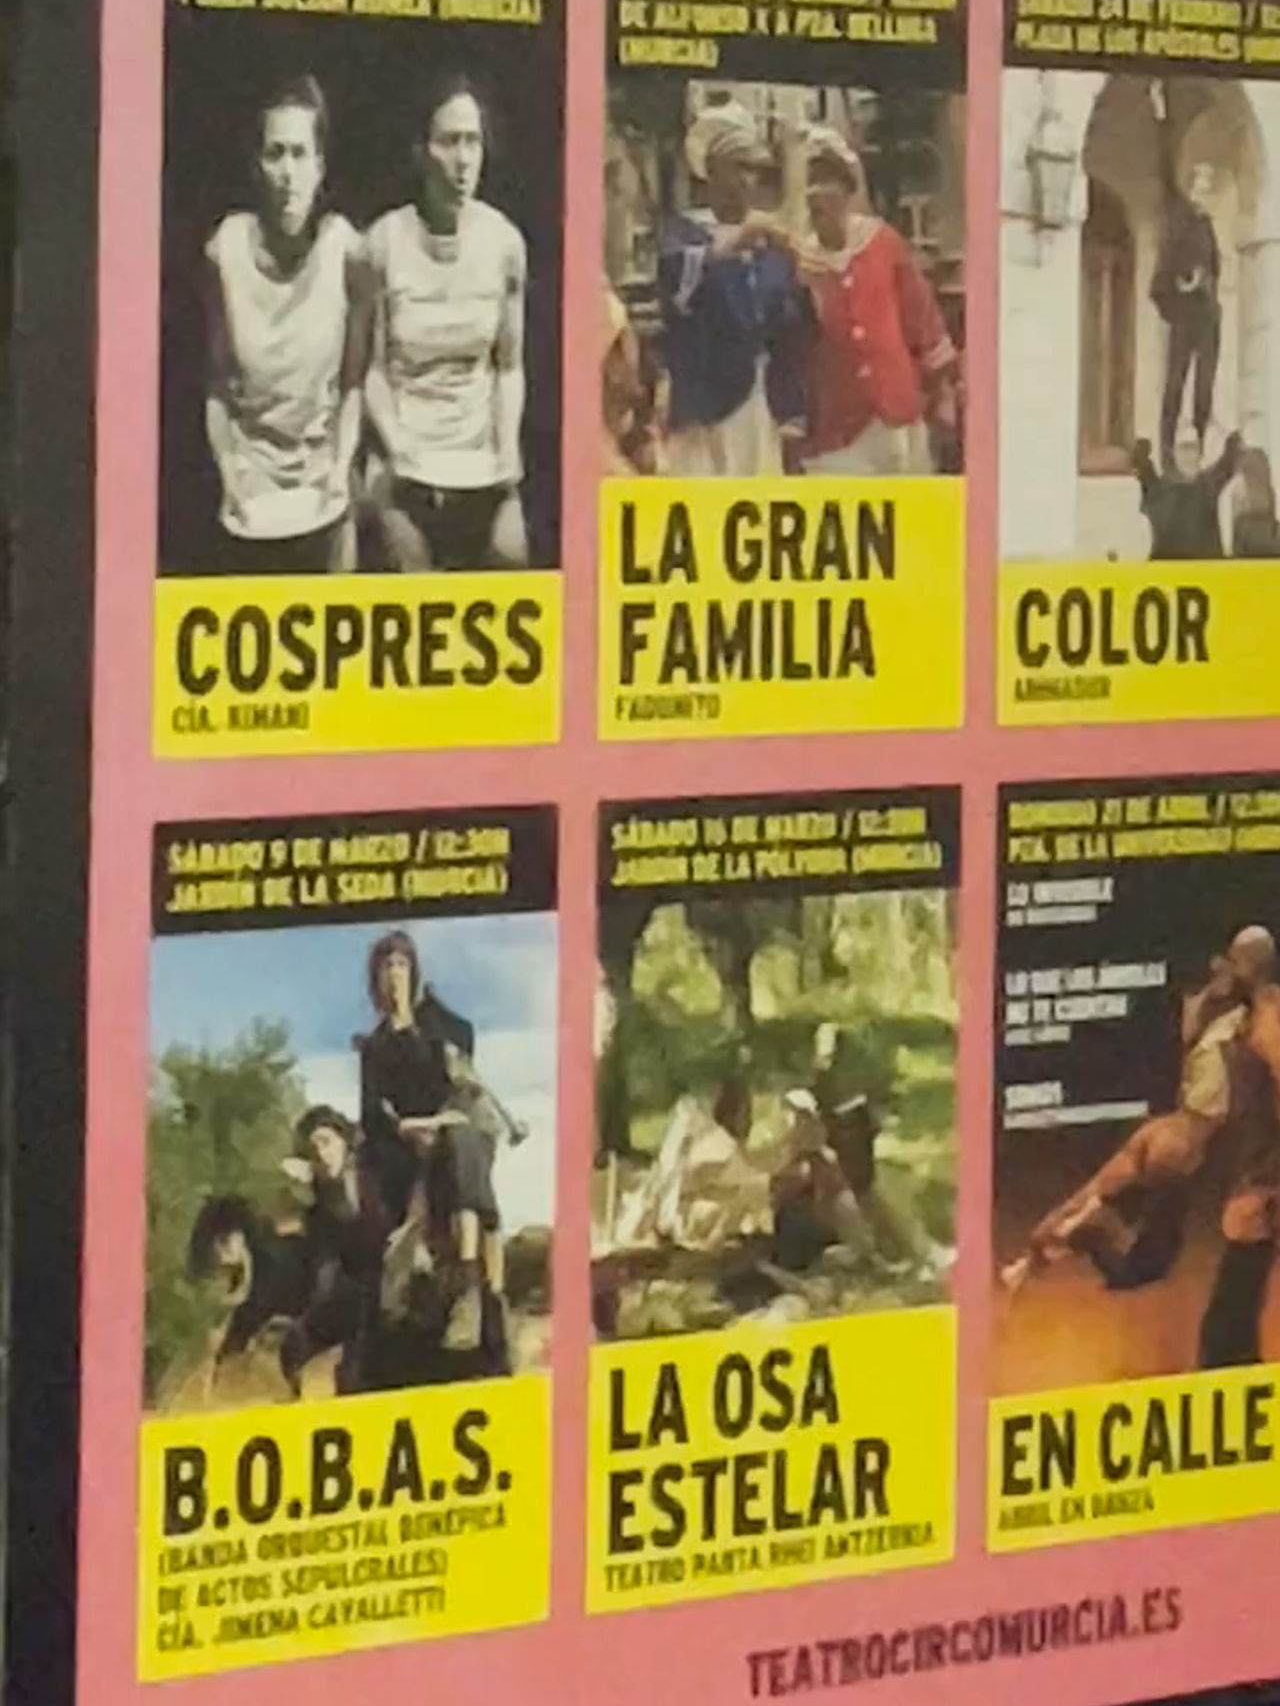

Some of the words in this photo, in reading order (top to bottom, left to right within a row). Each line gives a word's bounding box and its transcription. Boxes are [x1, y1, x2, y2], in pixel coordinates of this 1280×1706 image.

[621, 502, 698, 584] LA
[723, 501, 895, 582] GRAN
[177, 599, 542, 696] COSPRESS
[619, 598, 876, 685] FAMILIA
[1015, 586, 1209, 668] COLOR
[168, 836, 264, 874] SÁBADO
[271, 842, 287, 868] 9
[292, 836, 322, 866] DE
[329, 831, 410, 864] MARZO
[263, 876, 293, 908] DE
[301, 874, 330, 904] LA
[338, 871, 396, 903] SEDA
[402, 864, 509, 901] (MURCIA)
[693, 852, 720, 883] DE
[725, 851, 751, 880] LA
[610, 1362, 689, 1454] LA
[714, 1344, 838, 1439] OSA
[1002, 1409, 1076, 1496] EN
[1099, 1383, 1274, 1483] CALLE
[163, 1409, 511, 1537] B.O.B.A.S.
[608, 1437, 890, 1556] ESTELAR
[158, 1538, 249, 1576] (BANDA
[257, 1521, 388, 1562] ORQUESTAL
[158, 1586, 186, 1615] DE
[197, 1573, 271, 1609] ACTOS
[283, 1548, 448, 1593] SEPULCRALES)
[605, 1559, 684, 1592] TEATRO
[692, 1547, 760, 1578] PANTA
[307, 1586, 446, 1630] CAVALLETTI
[746, 1587, 1182, 1698] TEATROCIRCOMURCIA.ES
